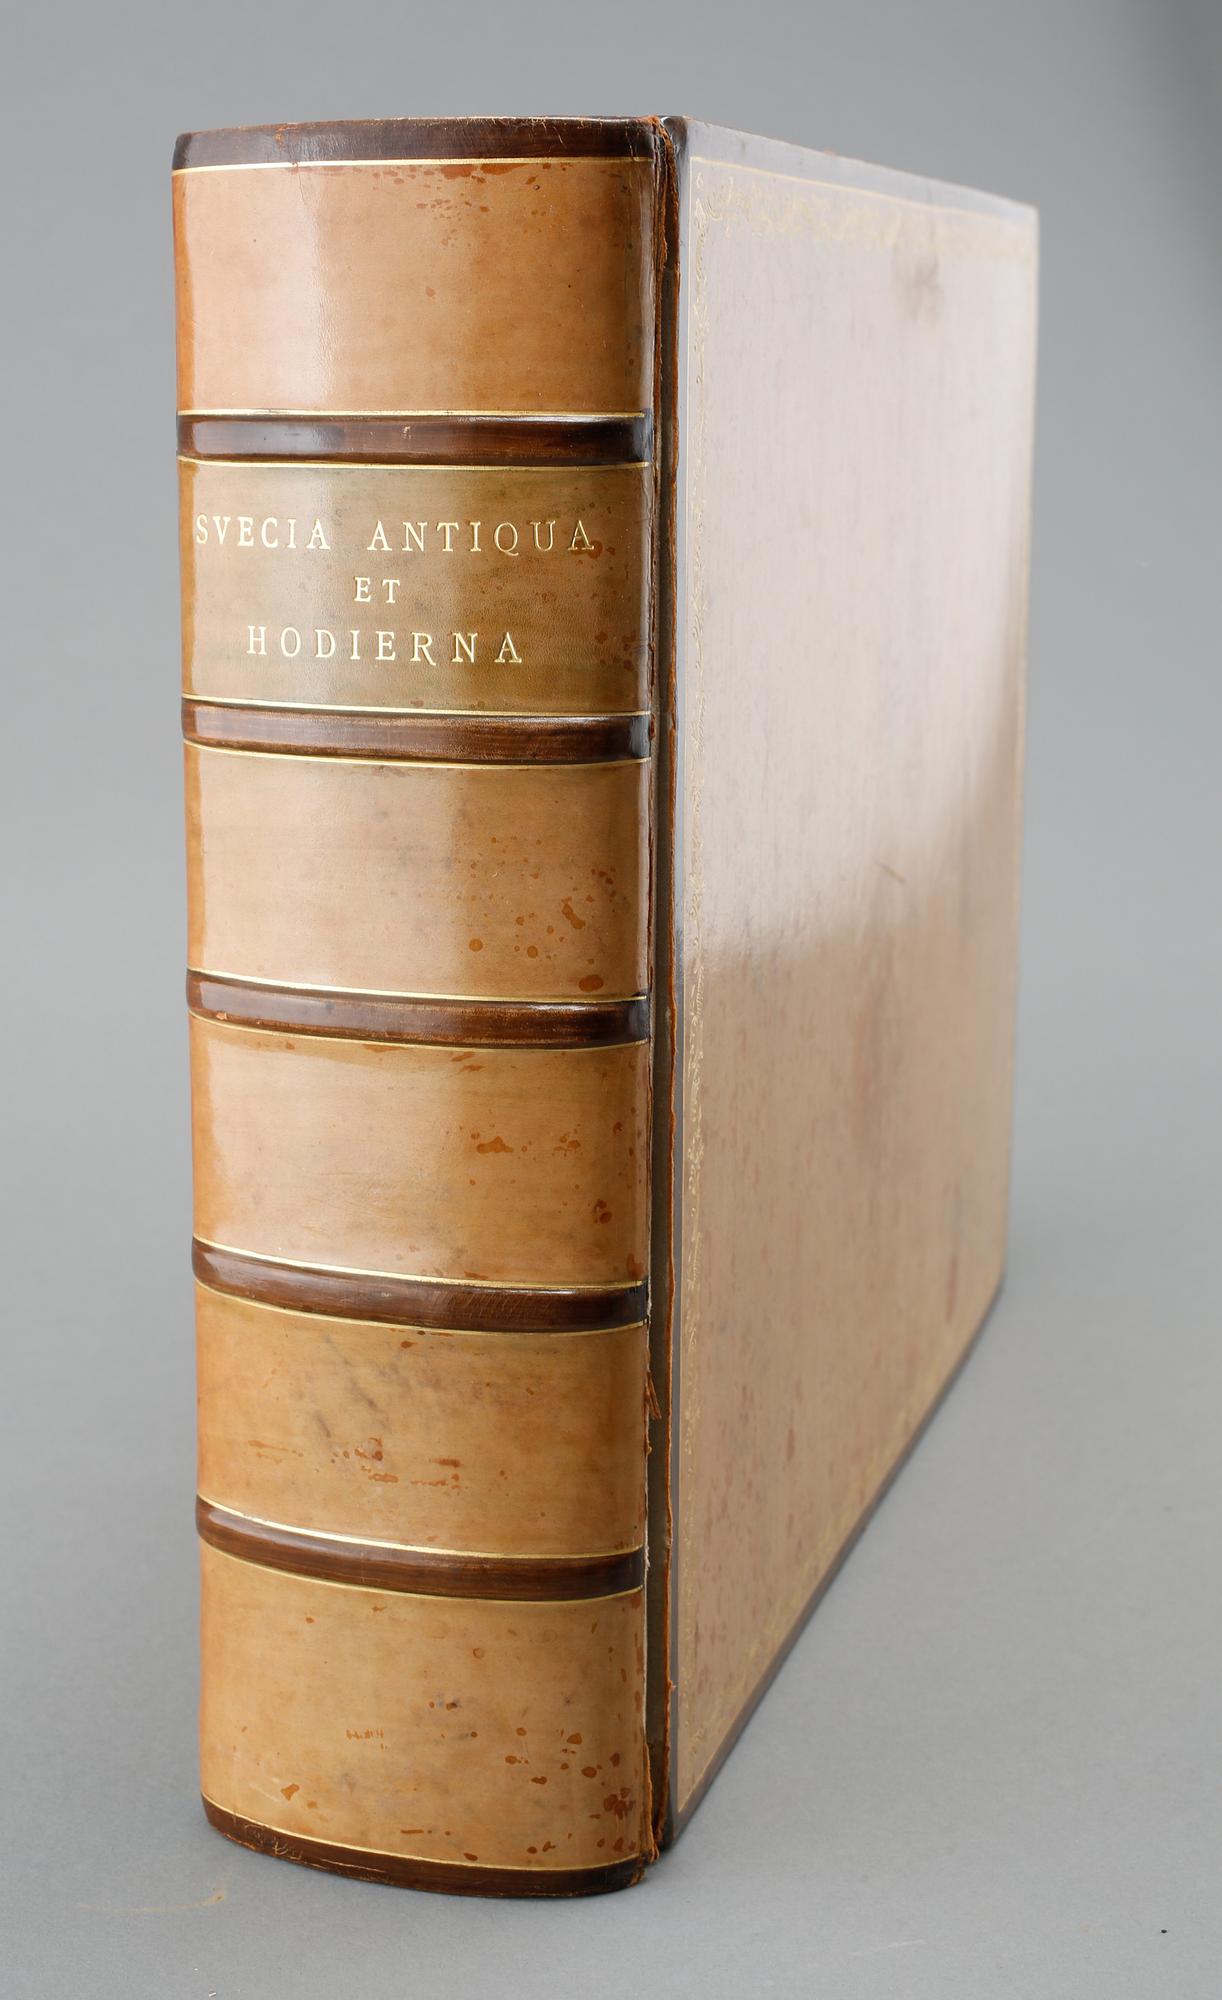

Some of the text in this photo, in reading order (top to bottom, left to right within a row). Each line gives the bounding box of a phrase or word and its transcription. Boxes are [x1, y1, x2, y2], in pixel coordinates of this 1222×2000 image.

[195, 513, 596, 556] SVECIA ANTIQUA
[353, 576, 401, 604] ET
[246, 624, 523, 667] HODIERNA
